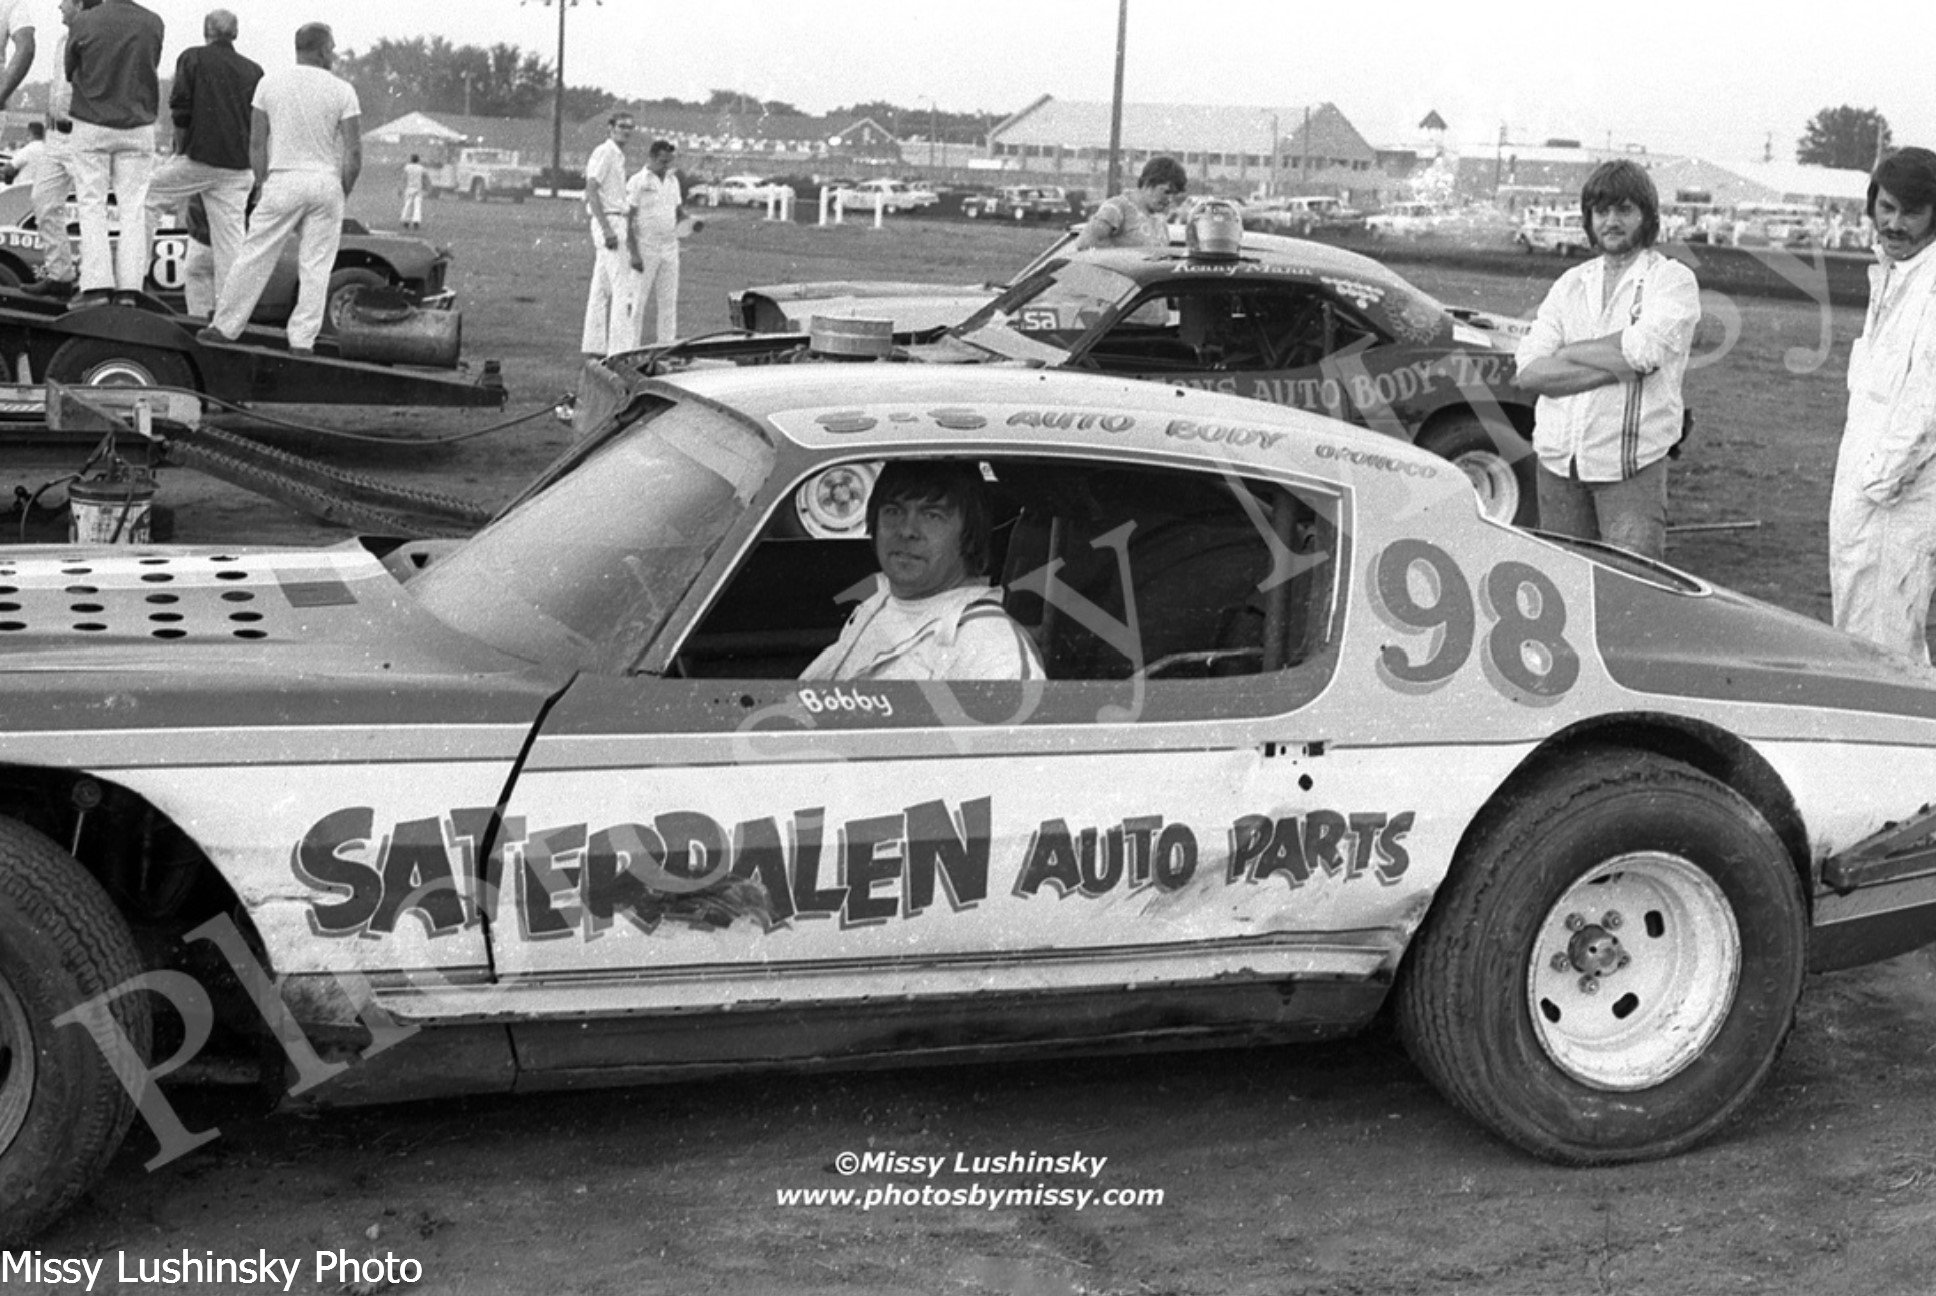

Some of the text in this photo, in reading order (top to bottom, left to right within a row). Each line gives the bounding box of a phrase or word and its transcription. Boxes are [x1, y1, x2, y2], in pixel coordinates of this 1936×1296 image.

[1171, 263, 1313, 276] Kenny Mann
[1252, 375, 1341, 410] AUTO
[1353, 360, 1437, 409] BODY
[1006, 411, 1136, 433] AUTO
[1165, 419, 1287, 449] BODY
[1365, 538, 1581, 708] 98
[798, 686, 893, 717] Bobby
[291, 796, 1417, 940] SATERDALEN AUTO PARTS
